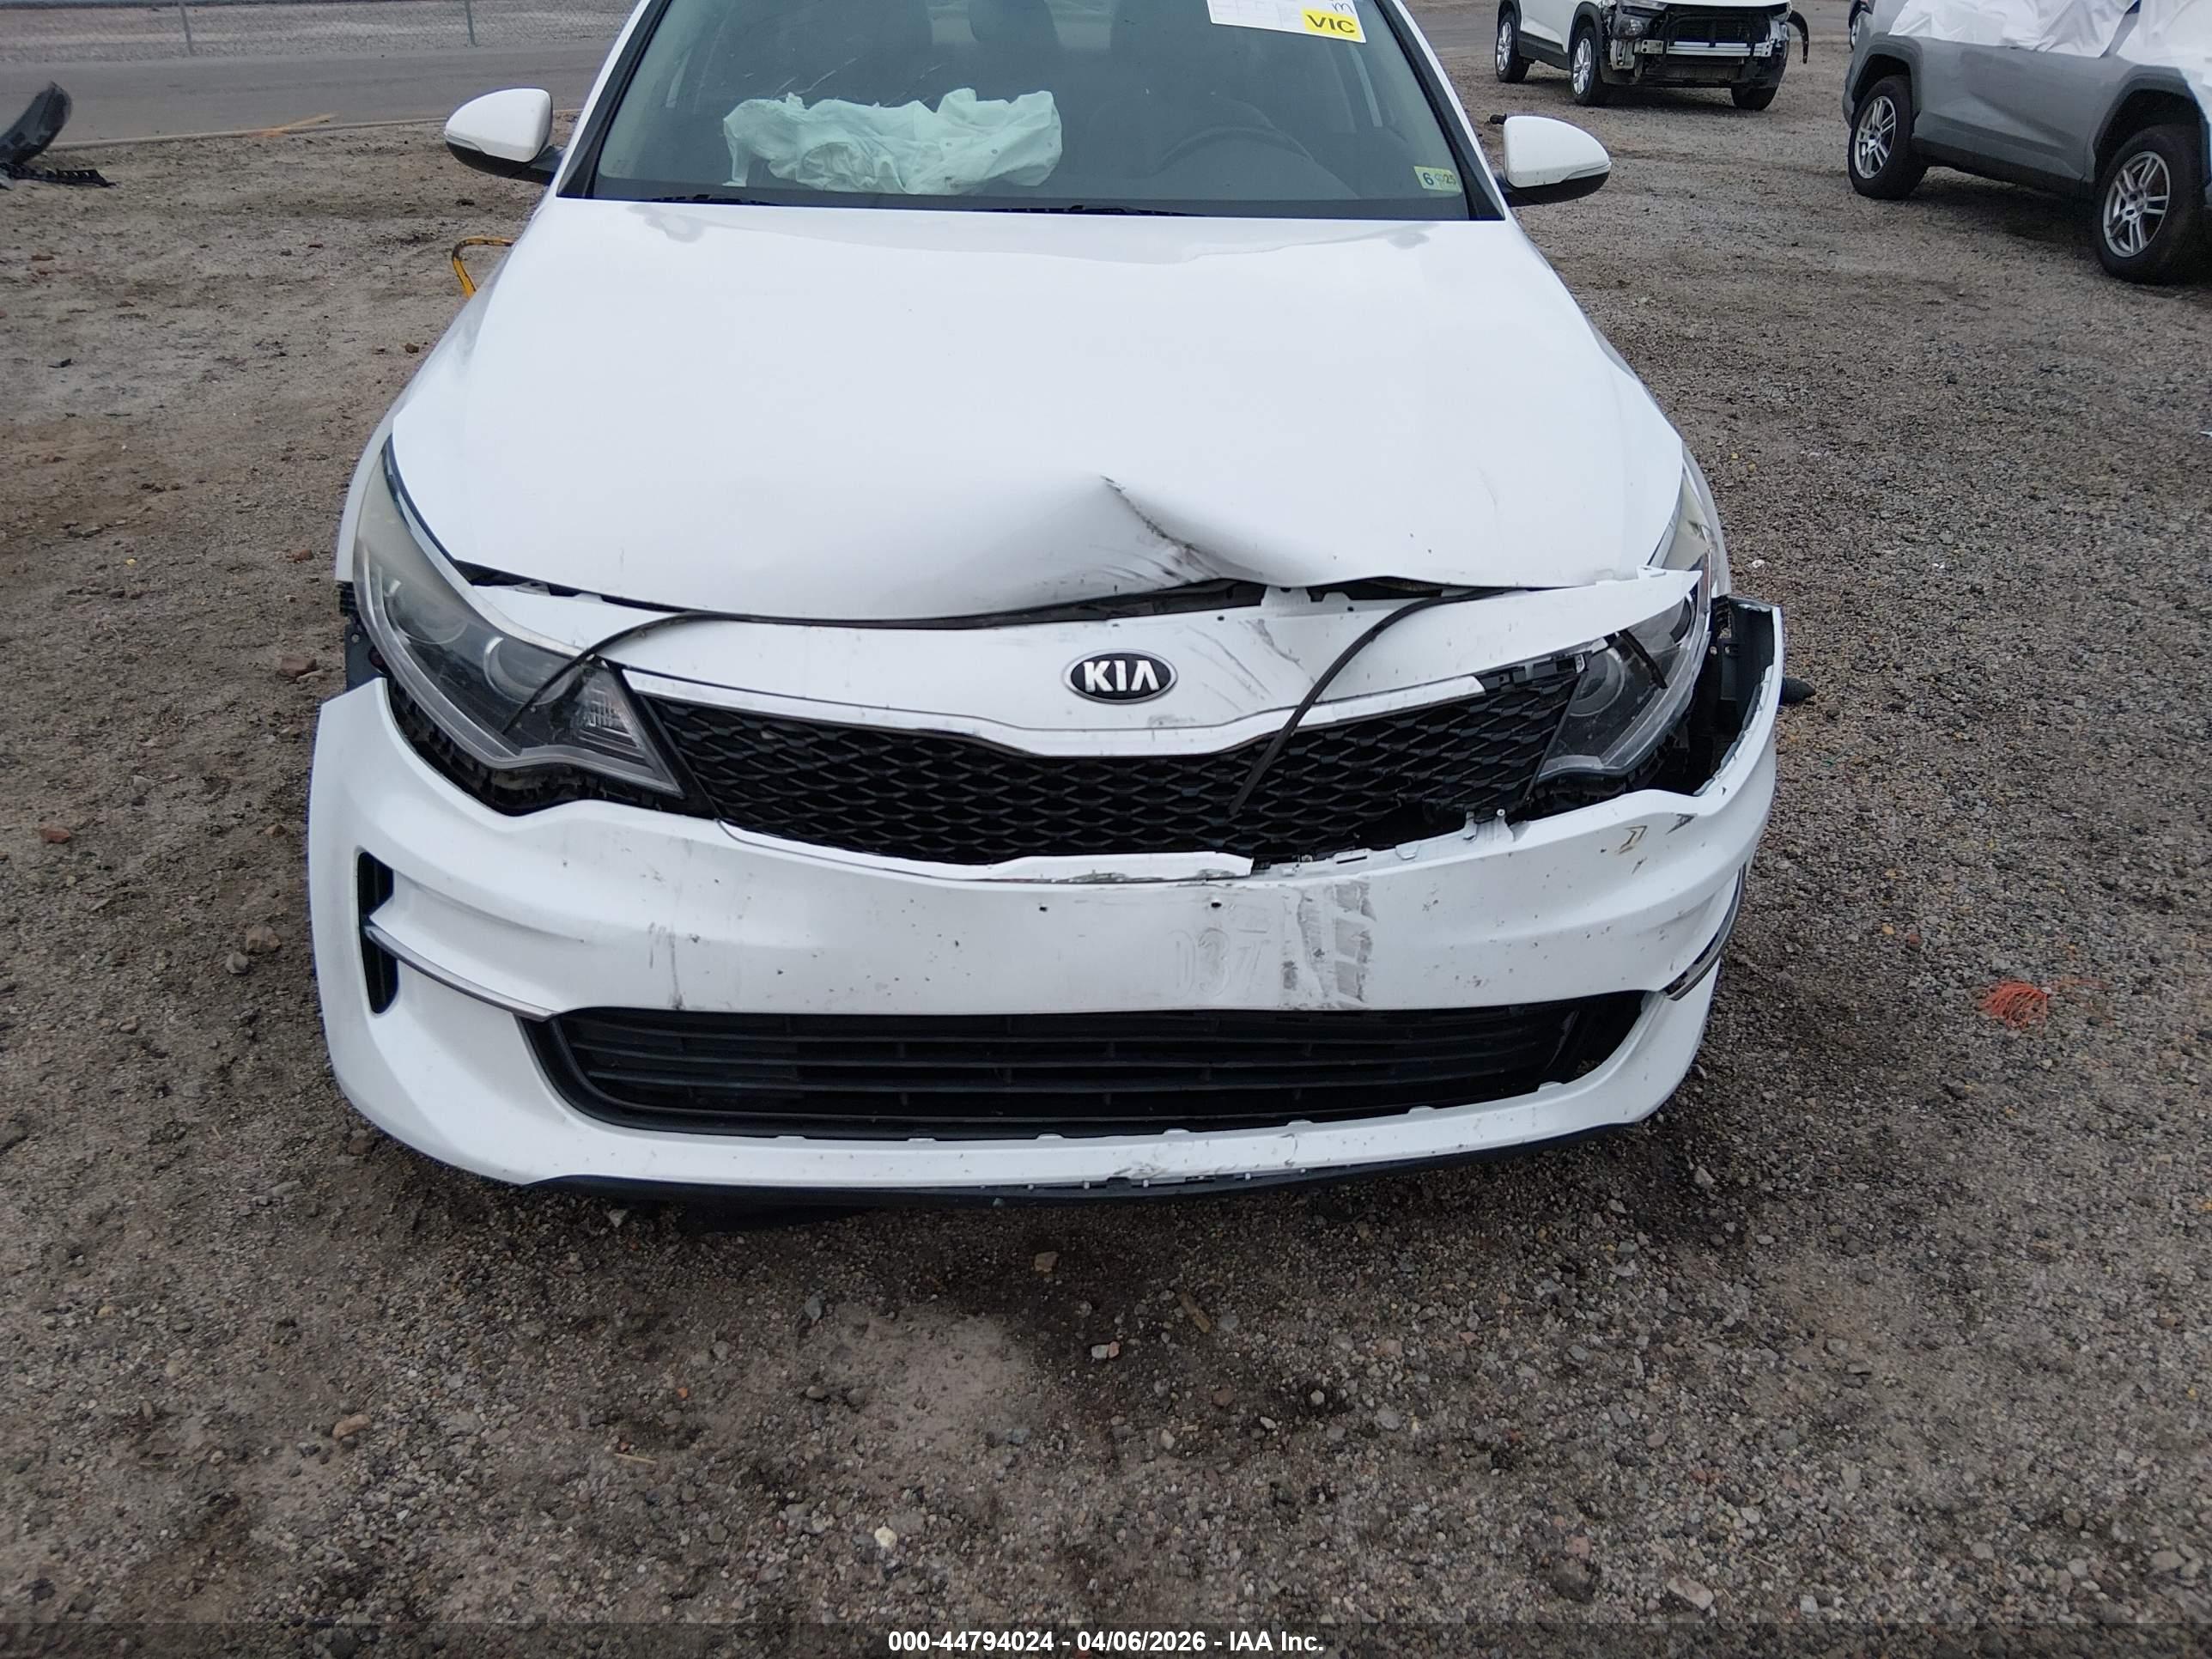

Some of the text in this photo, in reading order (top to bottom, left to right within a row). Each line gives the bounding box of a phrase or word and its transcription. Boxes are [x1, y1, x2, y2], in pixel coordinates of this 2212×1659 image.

[1306, 14, 1355, 33] VIC
[1423, 173, 1434, 185] 6
[1084, 660, 1160, 693] KIA
